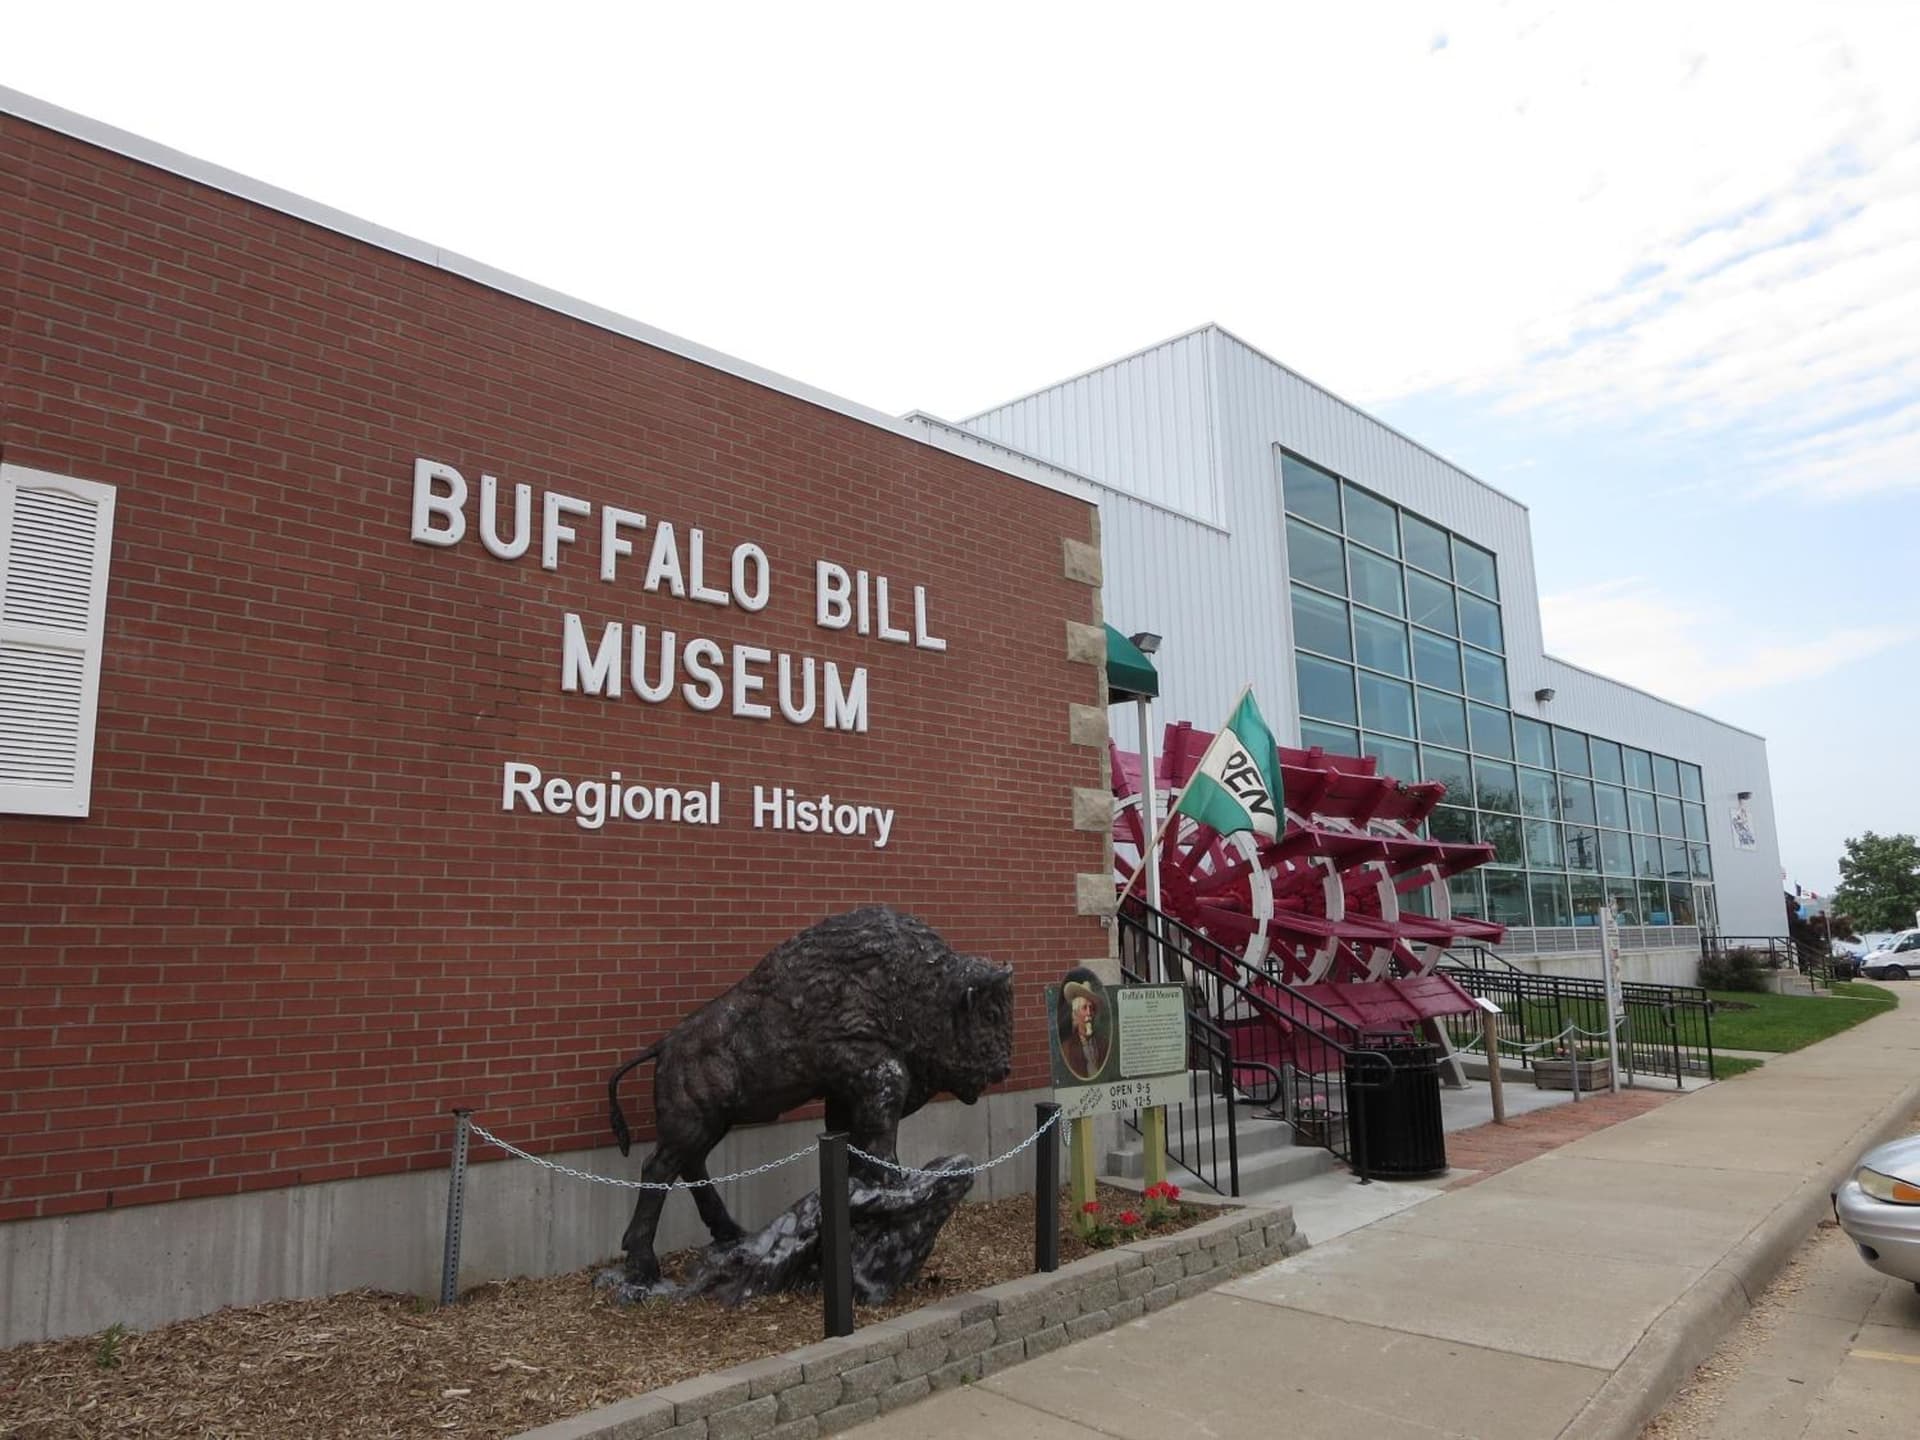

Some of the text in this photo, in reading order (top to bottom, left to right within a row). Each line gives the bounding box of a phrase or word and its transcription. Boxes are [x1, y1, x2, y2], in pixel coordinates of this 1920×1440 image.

[411, 457, 947, 651] BUFFALO BILL
[561, 612, 869, 732] MUSEUM
[502, 761, 895, 848] Regional History
[1221, 750, 1276, 817] PEN
[1110, 1084, 1133, 1097] OPEN
